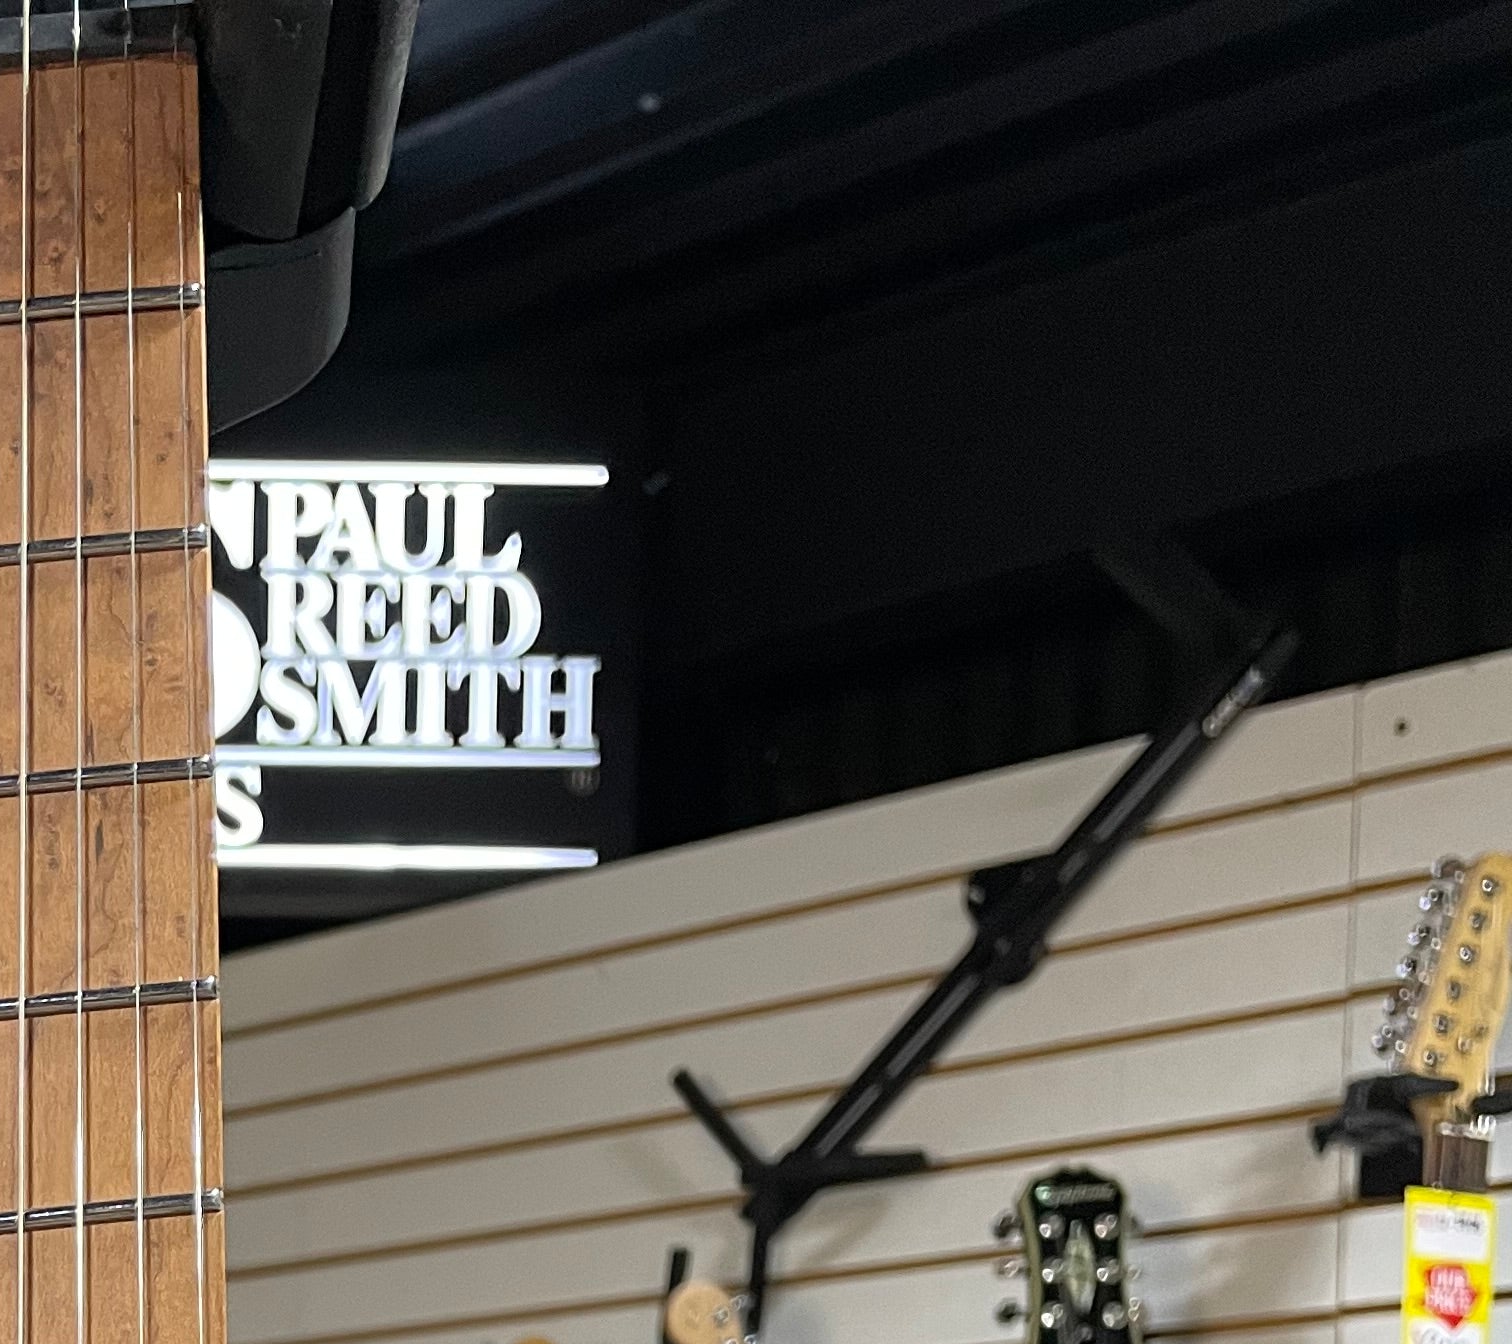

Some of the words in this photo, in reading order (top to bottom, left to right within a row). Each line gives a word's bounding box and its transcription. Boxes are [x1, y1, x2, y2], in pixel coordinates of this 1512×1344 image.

[260, 481, 522, 570] PAUL
[260, 568, 543, 660] REED
[257, 655, 600, 749] SMITH
